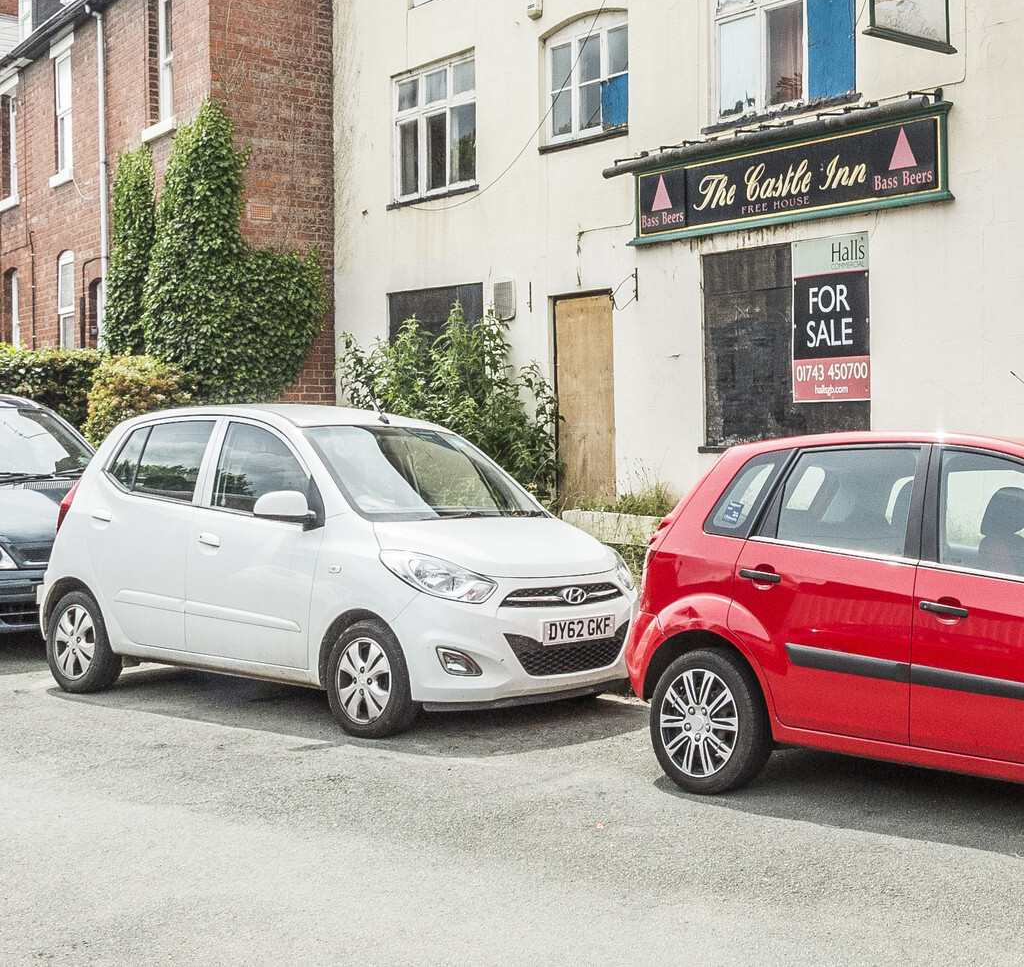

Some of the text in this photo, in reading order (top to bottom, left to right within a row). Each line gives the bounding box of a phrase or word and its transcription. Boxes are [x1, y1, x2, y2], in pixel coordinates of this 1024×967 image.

[693, 154, 867, 211] The Castle Inn
[874, 169, 933, 191] Bass Beers
[741, 196, 810, 215] FREE HOUSE
[641, 211, 685, 229] Bass Beers
[831, 239, 866, 263] Halls
[831, 260, 865, 270] COMMERCIAL
[808, 284, 850, 314] FOR
[806, 317, 853, 348] SALE
[796, 362, 868, 382] 01743 450700
[814, 385, 849, 397] hallsgb.com
[548, 617, 611, 641] DY62 GKF
